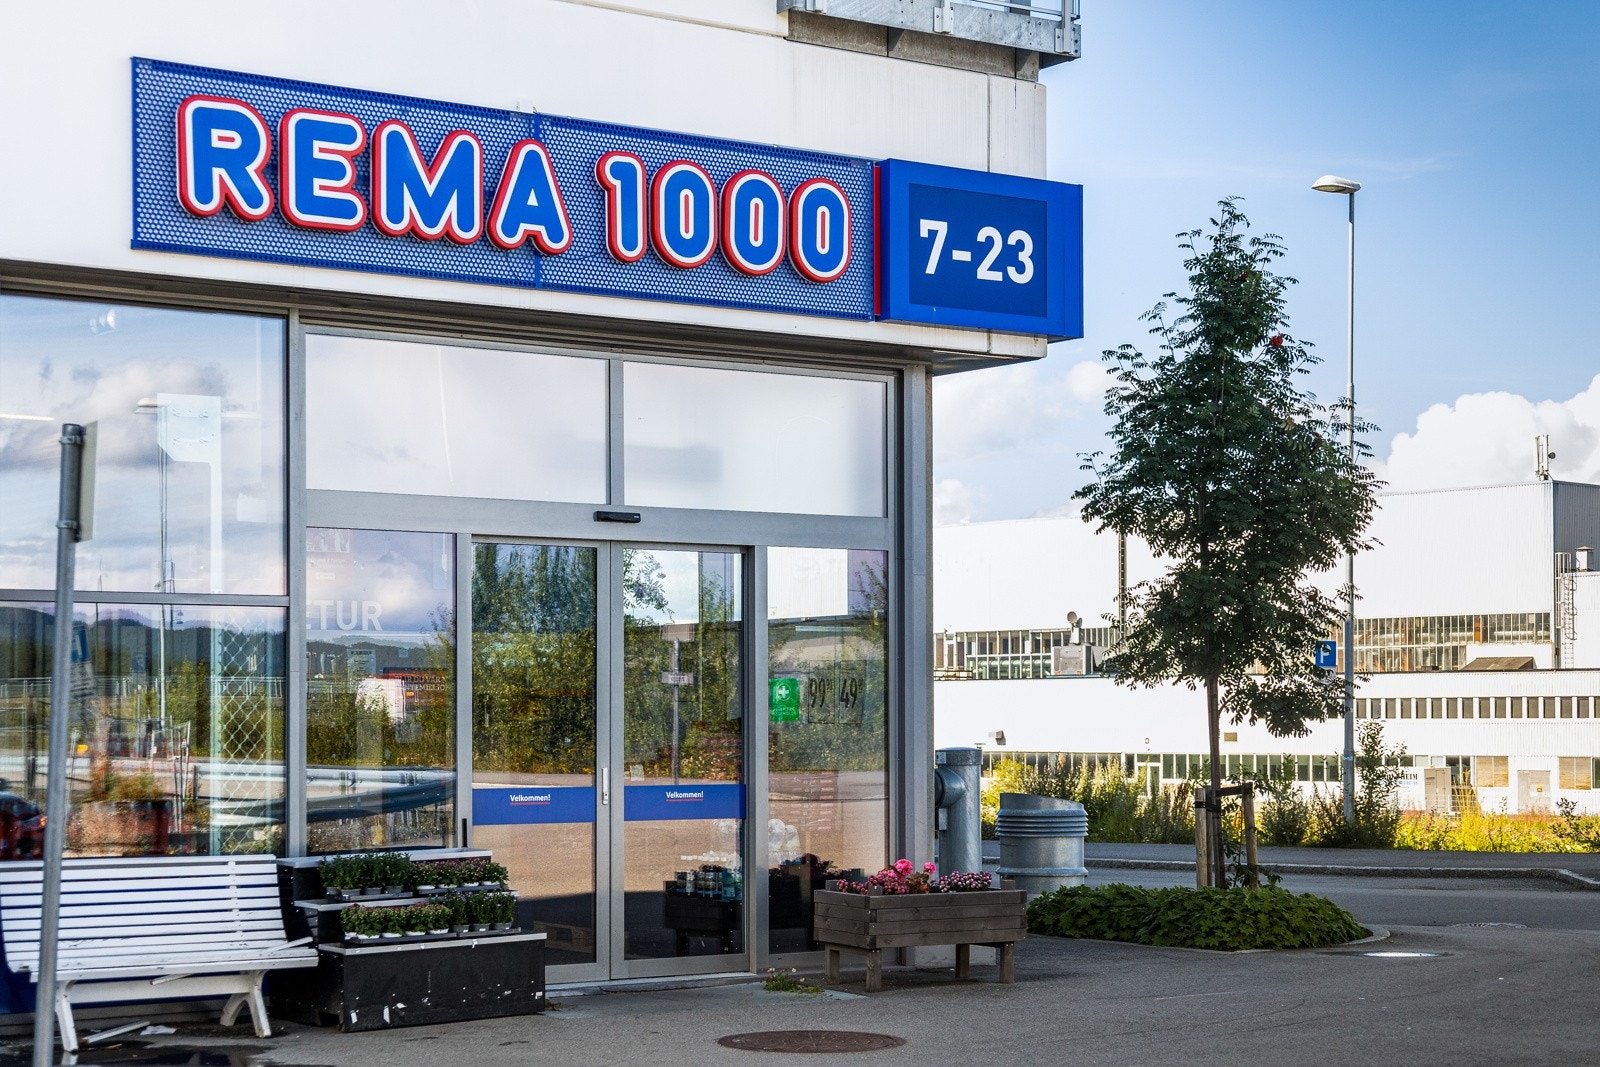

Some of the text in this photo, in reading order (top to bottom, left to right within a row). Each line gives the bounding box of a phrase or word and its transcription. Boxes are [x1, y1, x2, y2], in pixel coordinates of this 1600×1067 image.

[176, 94, 852, 283] REMA 1000
[919, 218, 1035, 285] 7-23
[509, 794, 551, 802] Velkommen!
[666, 790, 704, 799] Velkommen!
